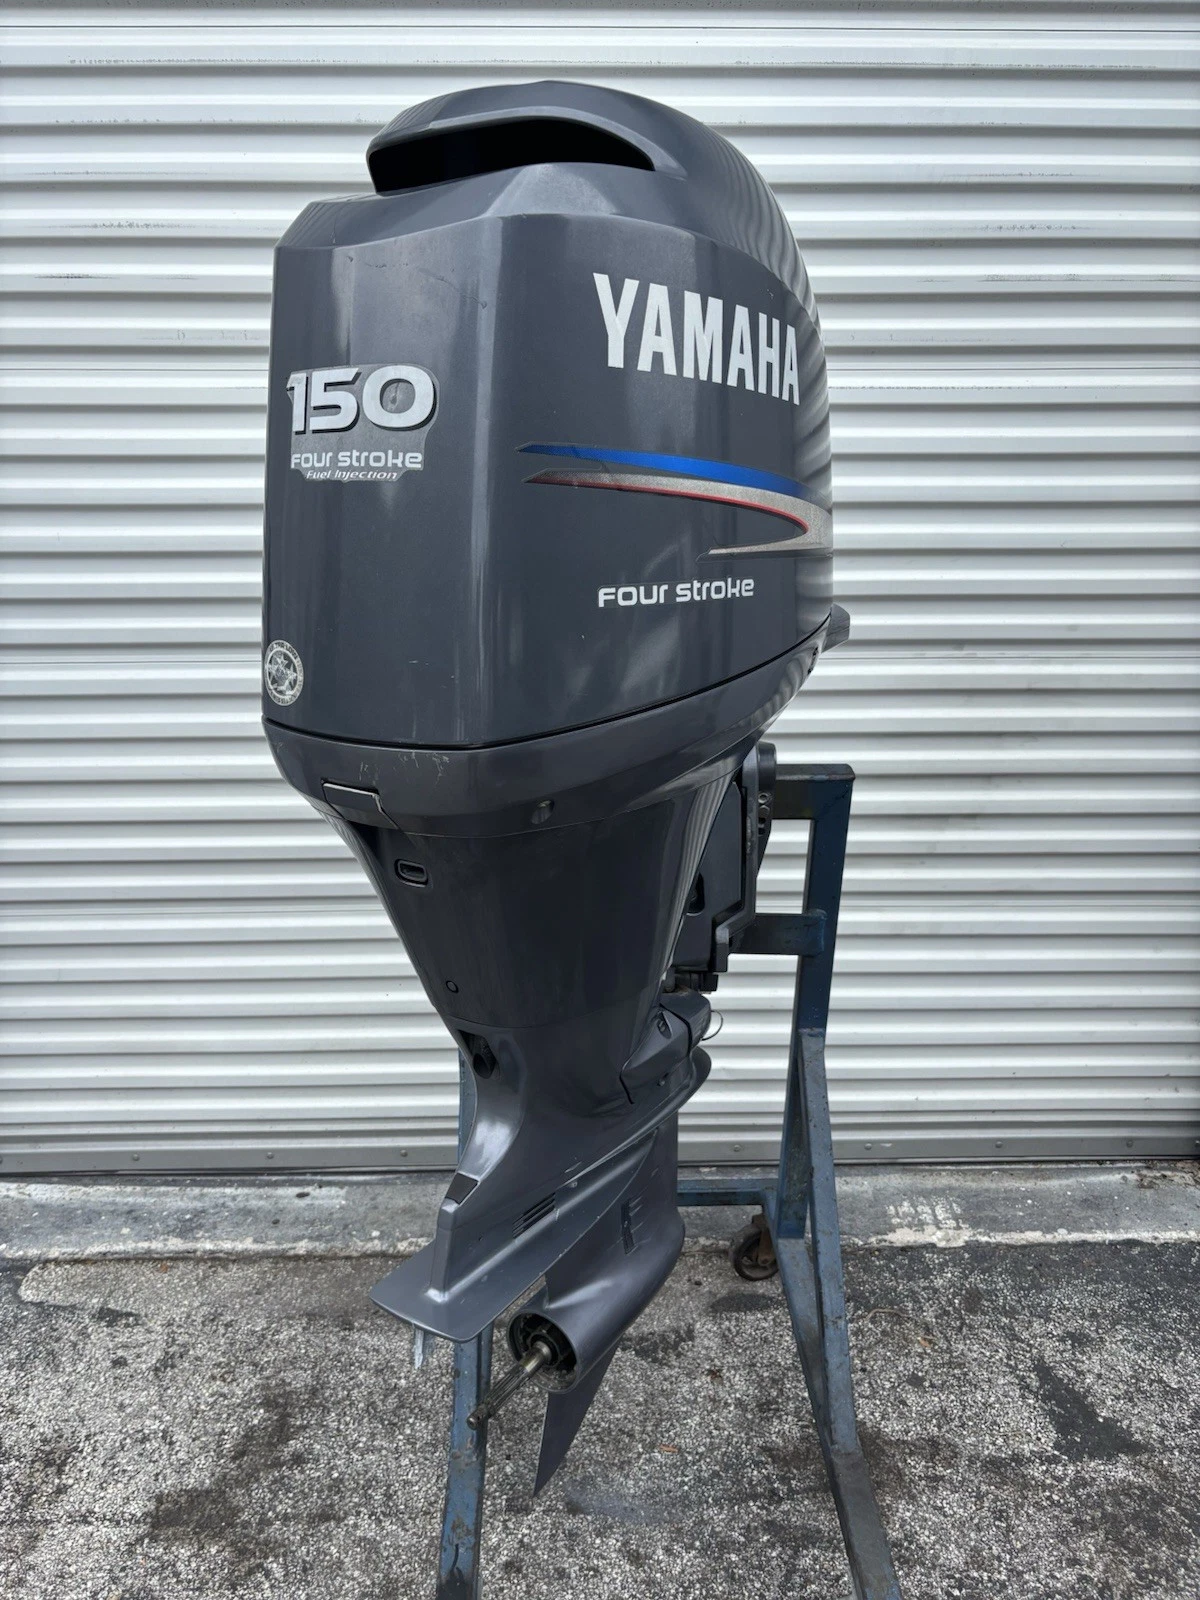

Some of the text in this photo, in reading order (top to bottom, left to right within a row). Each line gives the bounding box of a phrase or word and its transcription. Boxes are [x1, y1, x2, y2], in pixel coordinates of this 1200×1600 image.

[593, 272, 800, 406] YAMAHA
[286, 364, 437, 434] 150
[306, 469, 398, 480] Fuel Injection
